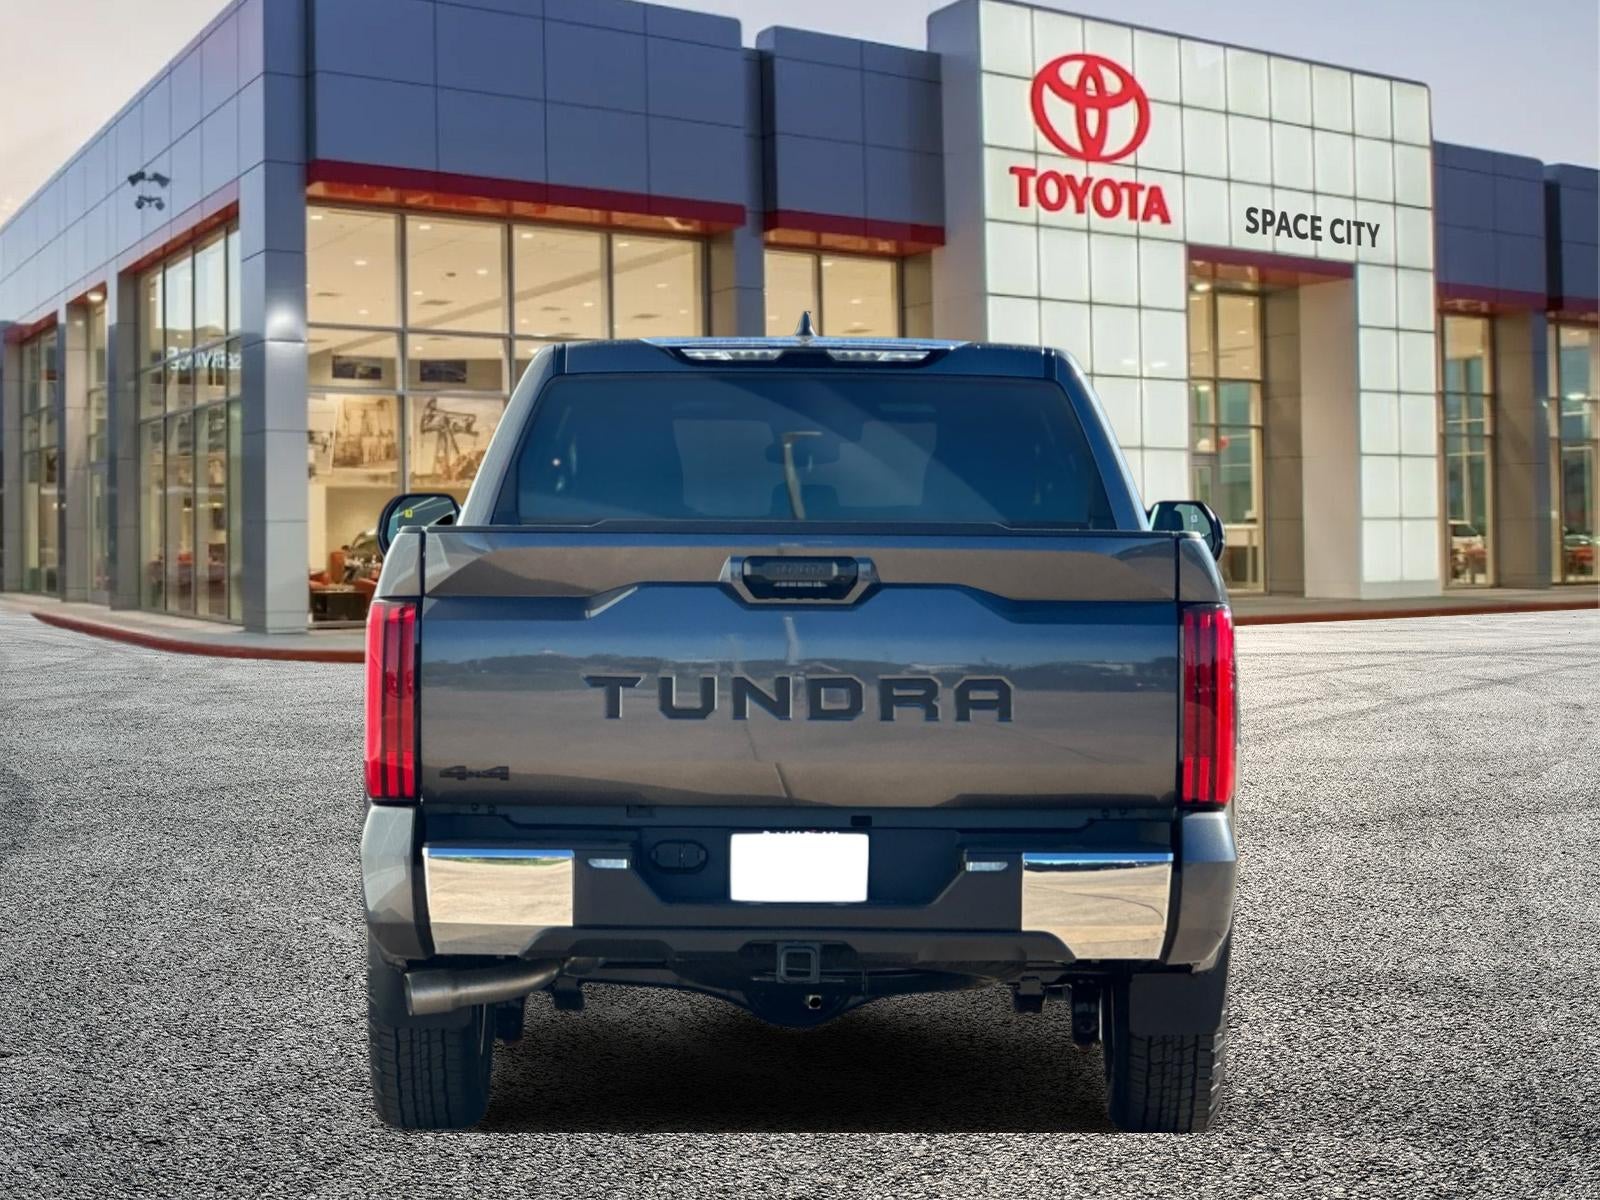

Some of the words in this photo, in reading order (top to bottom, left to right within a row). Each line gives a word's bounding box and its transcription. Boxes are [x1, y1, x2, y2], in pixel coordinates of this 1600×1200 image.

[1009, 166, 1171, 224] TOYOTA
[1245, 206, 1323, 242] SPACE
[1329, 217, 1381, 248] CITY
[581, 673, 1014, 722] TUNDRA
